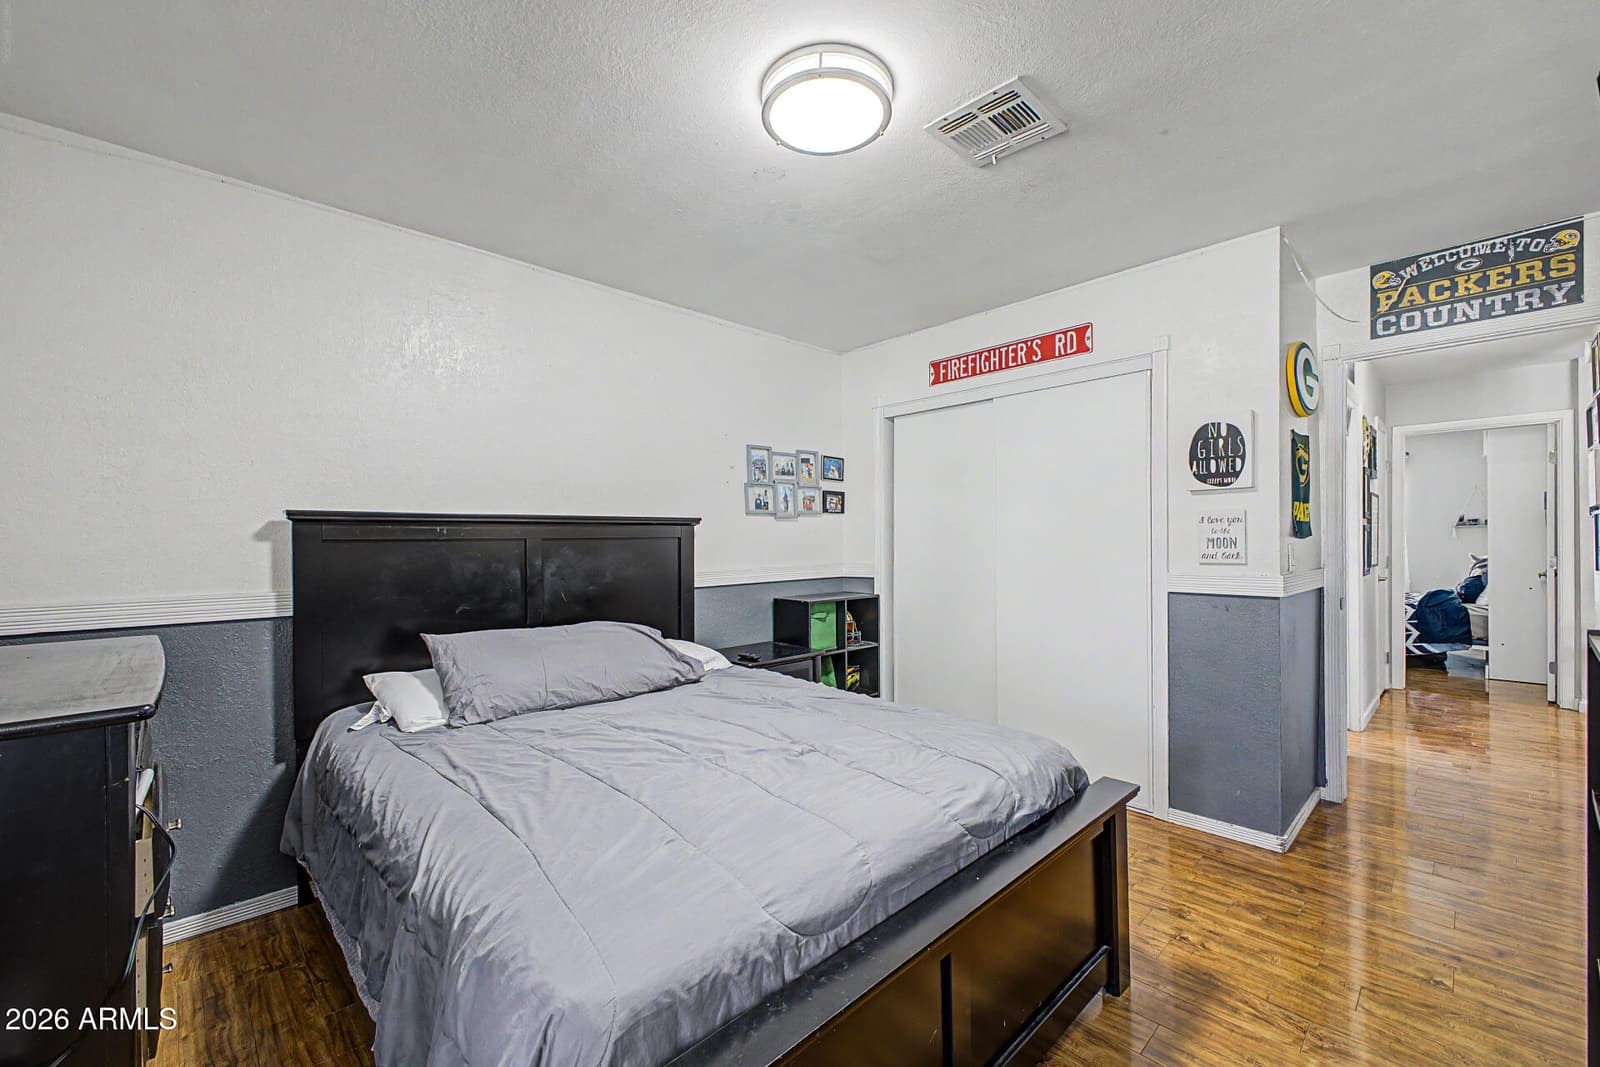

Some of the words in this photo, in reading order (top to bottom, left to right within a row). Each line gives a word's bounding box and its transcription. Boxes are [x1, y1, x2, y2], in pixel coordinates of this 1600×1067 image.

[1516, 238, 1545, 252] TO
[1376, 252, 1577, 313] PACKERS
[1376, 280, 1576, 336] COUNTRY
[939, 339, 1042, 382] FIREFIGHTER'S
[1055, 331, 1077, 357] RD
[1197, 436, 1244, 459] GIRLS
[1192, 457, 1242, 475] ALLOWED
[1226, 517, 1243, 527] you
[1206, 537, 1237, 549] MOON
[1201, 552, 1218, 560] and
